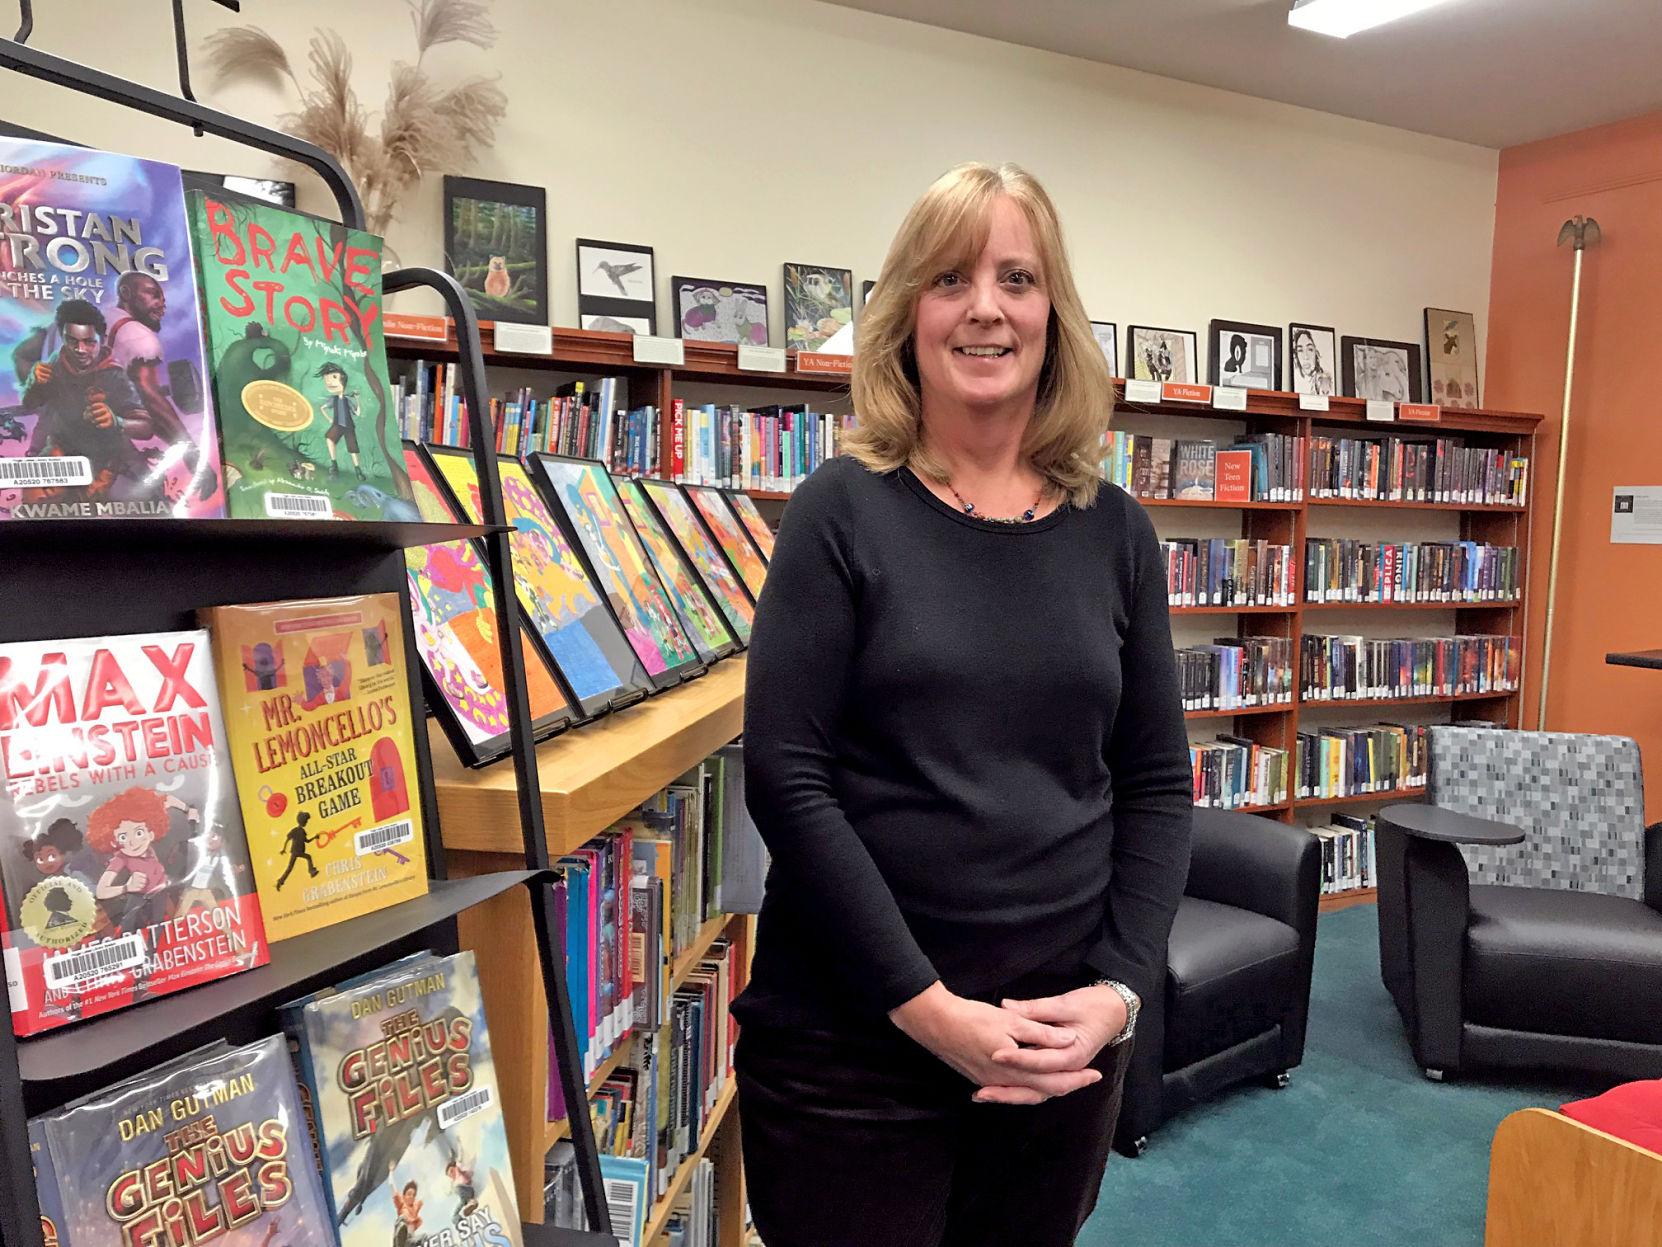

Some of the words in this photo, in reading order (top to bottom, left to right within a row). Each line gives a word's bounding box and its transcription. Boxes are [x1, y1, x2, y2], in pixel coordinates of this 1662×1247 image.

[51, 171, 107, 186] PRESENTS
[205, 196, 378, 296] BRAVE
[7, 282, 55, 300] THE
[61, 286, 105, 304] SKY
[51, 274, 60, 284] A
[65, 275, 103, 288] HOLE
[219, 268, 379, 351] STORY
[803, 357, 815, 367] YA
[816, 359, 853, 369] Non-Fictio
[1183, 388, 1202, 398] Fiction
[675, 402, 684, 425] PICK
[674, 426, 683, 443] ME
[674, 444, 683, 459] UP
[1180, 444, 1215, 460] WHITE
[1180, 460, 1215, 477] ROSE
[1224, 462, 1241, 471] New
[1225, 473, 1241, 481] Teen
[1219, 483, 1245, 493] Fiction
[11, 501, 92, 519] KWAME
[96, 500, 170, 517] MBALIA
[1384, 549, 1393, 592] EPLICA
[0, 643, 208, 731] MAX
[261, 693, 302, 731] MR.
[0, 711, 215, 780] ENSTEIN
[252, 695, 397, 774] LEMONCELLO'S
[300, 747, 358, 780] ALL-STAR
[8, 773, 80, 797] BELS
[89, 765, 136, 785] WITH
[144, 762, 156, 777] A
[295, 758, 373, 804] BREAKOUT
[318, 787, 362, 819] GAME
[122, 905, 242, 952] TTERSON
[44, 985, 69, 1004] AND
[351, 993, 383, 1020] DAN
[386, 972, 446, 1008] GUTMAN
[39, 1006, 65, 1019] Authors
[65, 1004, 72, 1012] of
[72, 1000, 83, 1009] the
[381, 1008, 420, 1037] THE
[118, 1107, 164, 1143] DAN
[170, 1073, 256, 1121] GUTMAN
[163, 1114, 218, 1152] THE
[456, 1204, 493, 1241] SAY
